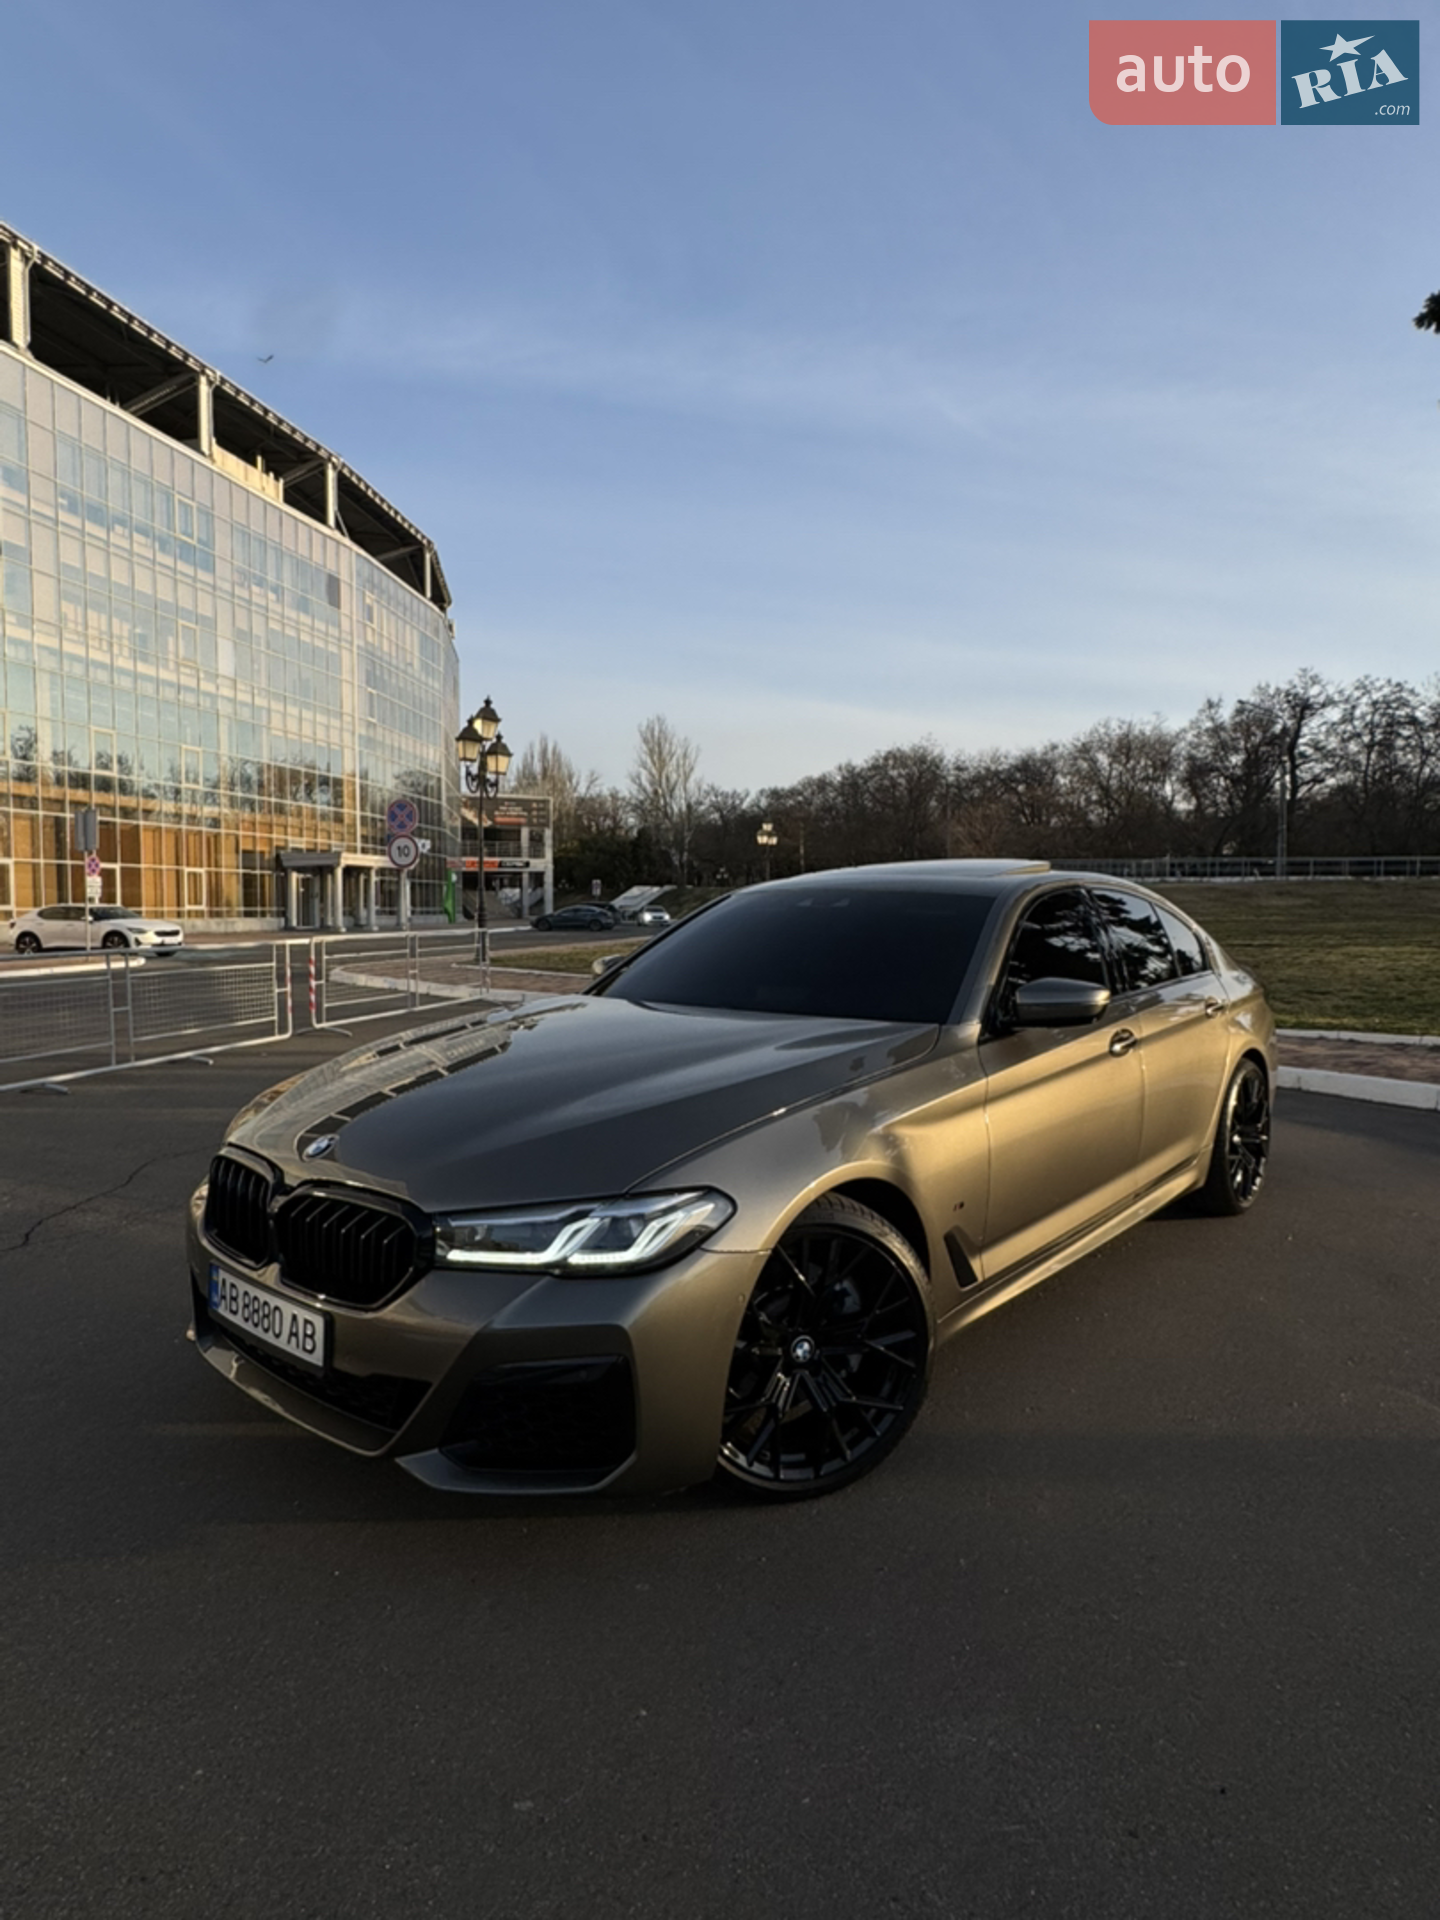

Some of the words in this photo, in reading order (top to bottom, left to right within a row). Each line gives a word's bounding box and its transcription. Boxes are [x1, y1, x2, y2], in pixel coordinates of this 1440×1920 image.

[396, 844, 411, 858] 10
[219, 1277, 239, 1317] AB
[241, 1290, 284, 1339] 8880
[287, 1313, 317, 1355] AB
